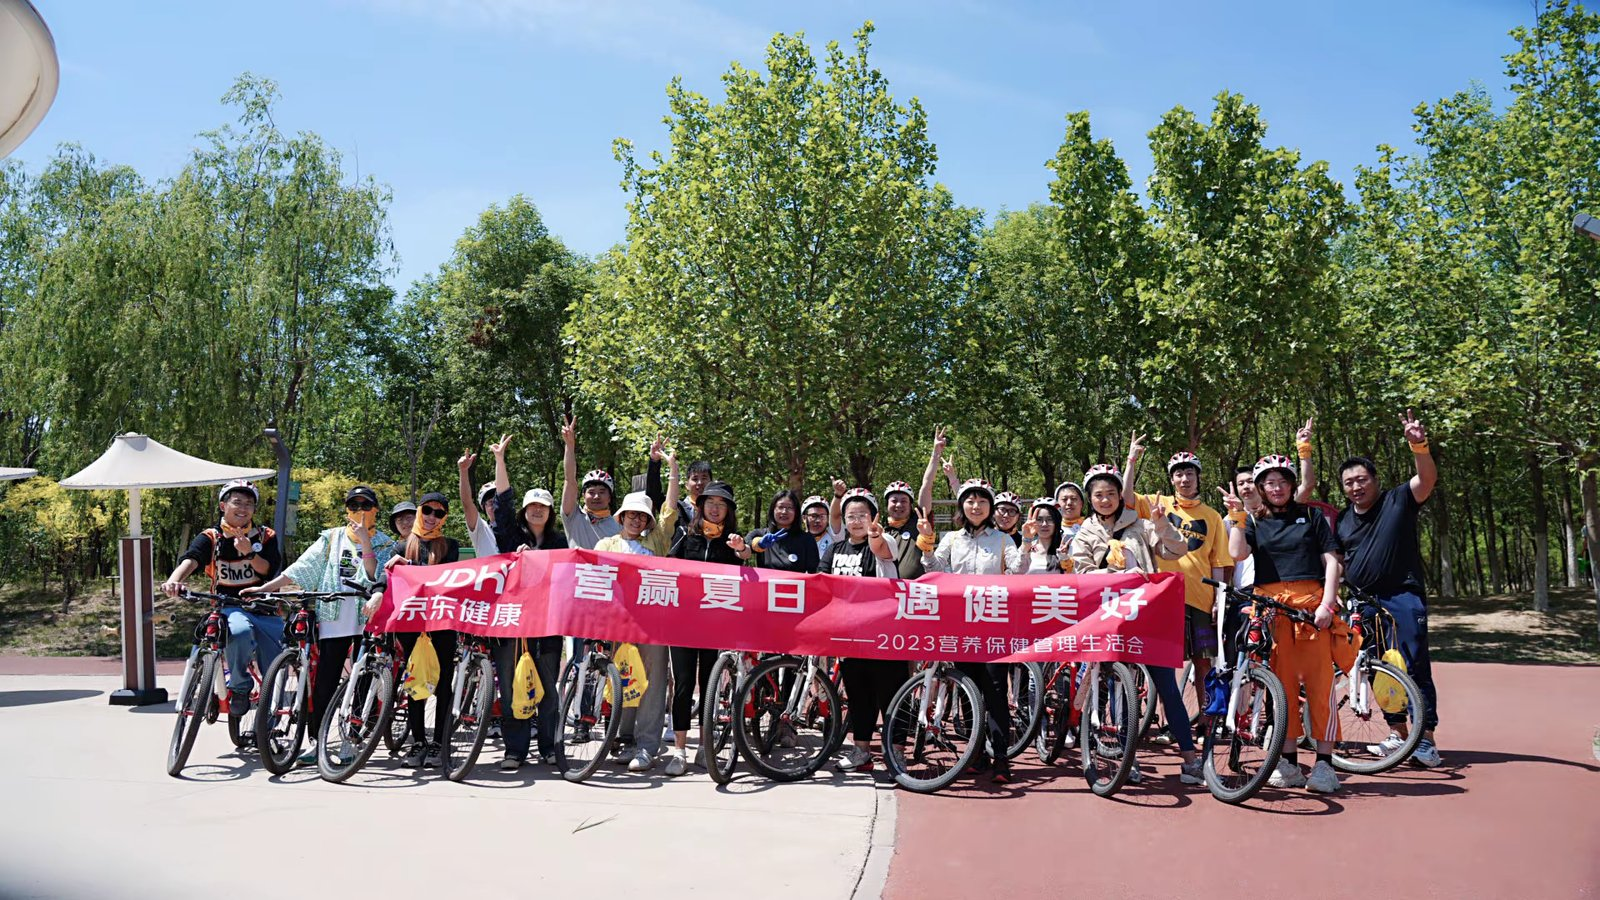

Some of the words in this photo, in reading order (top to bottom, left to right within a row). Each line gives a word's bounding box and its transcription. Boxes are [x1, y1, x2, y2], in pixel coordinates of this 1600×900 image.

[397, 594, 523, 627] 京东健康
[574, 563, 806, 614] 营赢夏日
[894, 581, 1149, 625] 遇健美好
